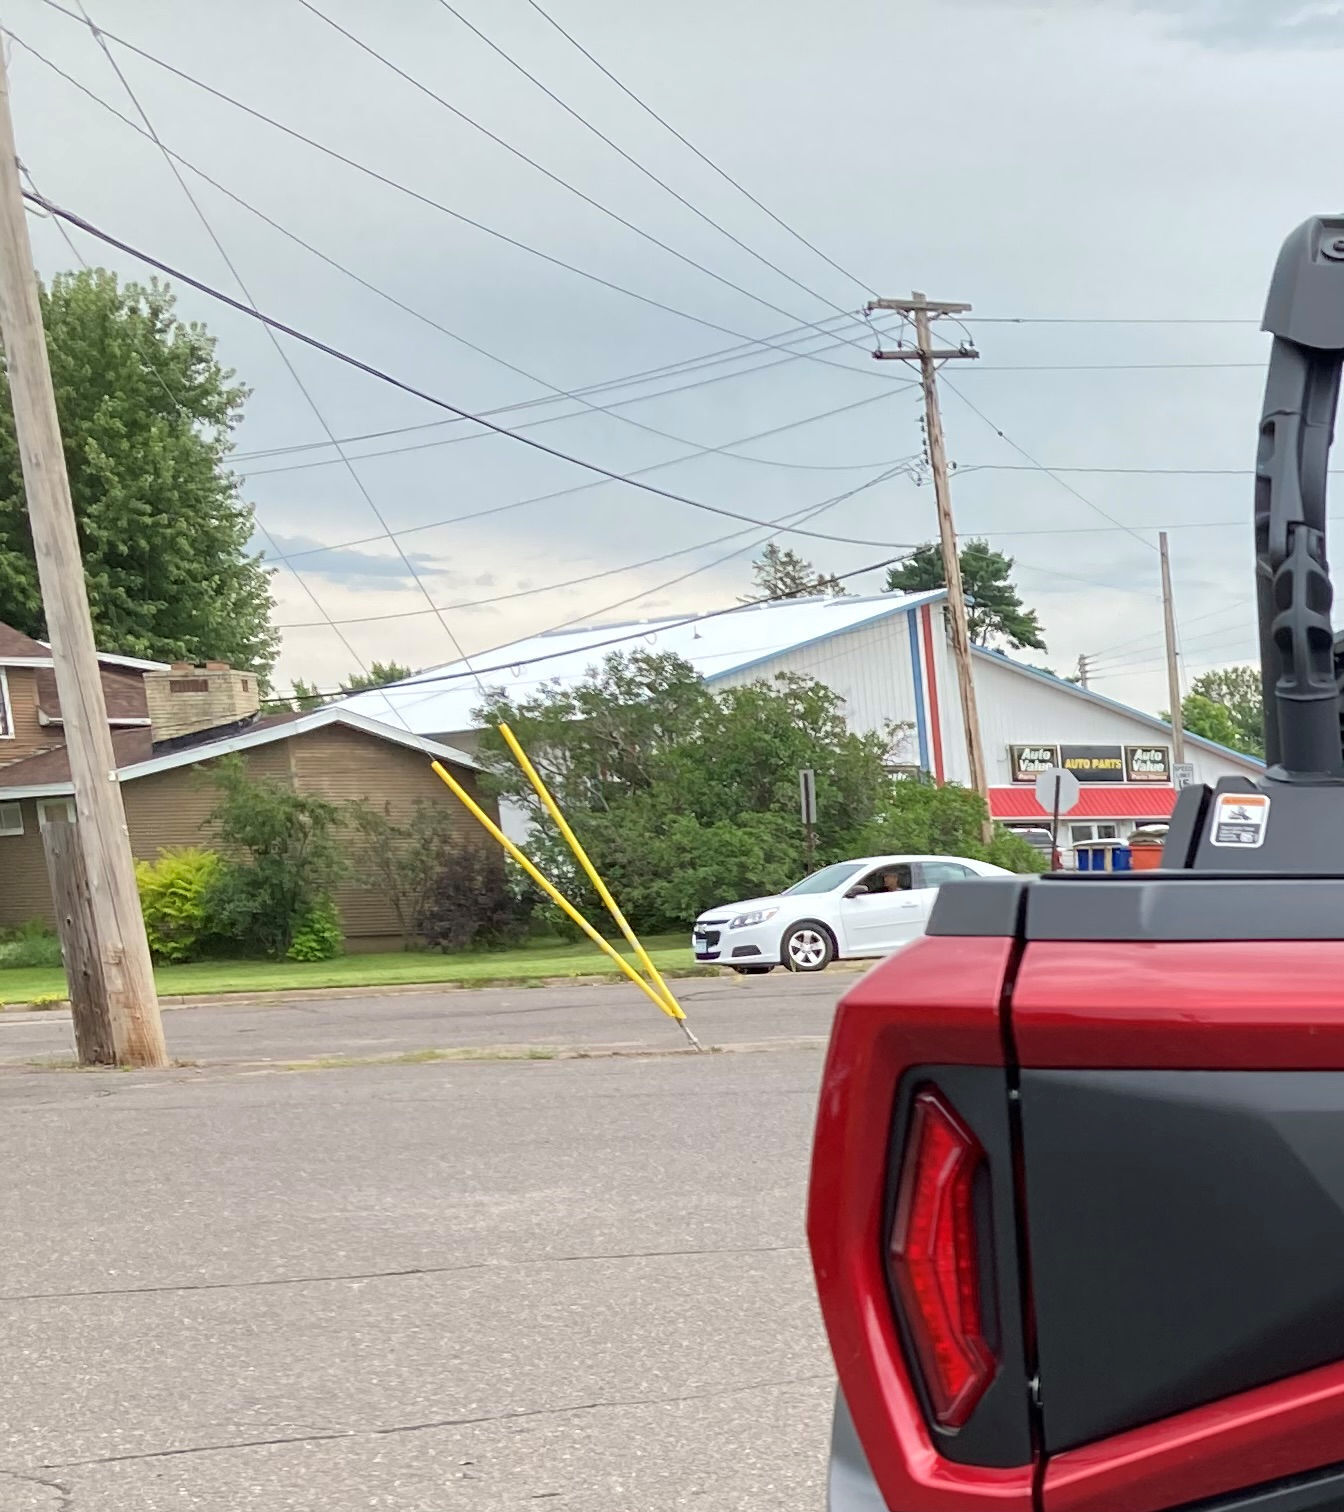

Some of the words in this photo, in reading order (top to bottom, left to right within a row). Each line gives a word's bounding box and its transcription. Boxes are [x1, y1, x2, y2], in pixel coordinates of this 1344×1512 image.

[1021, 748, 1051, 760] Auto
[1134, 749, 1162, 760] Auto
[1064, 758, 1090, 769] AUTO
[1092, 758, 1122, 769] PARTS
[1132, 760, 1165, 772] Value
